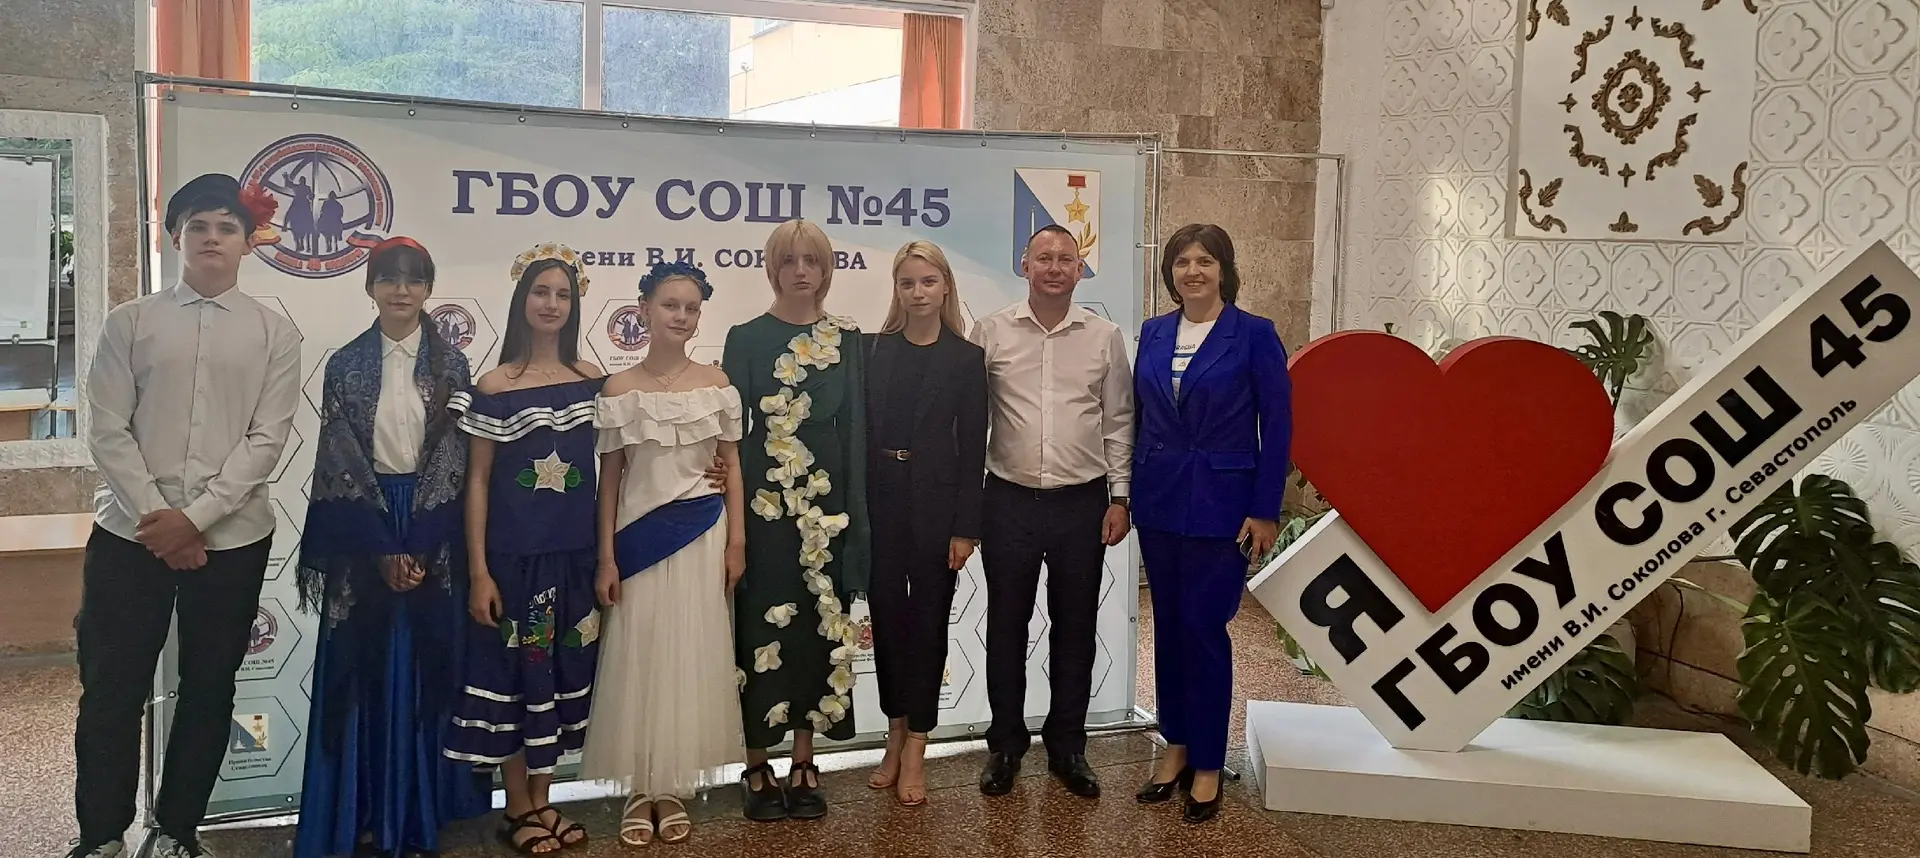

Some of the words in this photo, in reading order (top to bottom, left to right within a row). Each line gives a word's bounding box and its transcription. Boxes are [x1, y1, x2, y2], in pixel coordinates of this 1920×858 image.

[452, 170, 635, 219] ГБОУ
[655, 179, 806, 223] СОШ
[826, 184, 951, 228] №45
[575, 250, 636, 267] ени
[1371, 530, 1577, 732] ГБОУ
[1594, 364, 1803, 546] СОШ
[1809, 274, 1911, 378] 45
[1500, 635, 1565, 691] имени
[1562, 602, 1608, 638] В.И.
[1607, 521, 1705, 601] Соколова
[1705, 507, 1726, 523] г.
[1725, 399, 1857, 504] Севастополь
[1299, 553, 1405, 665] Я
